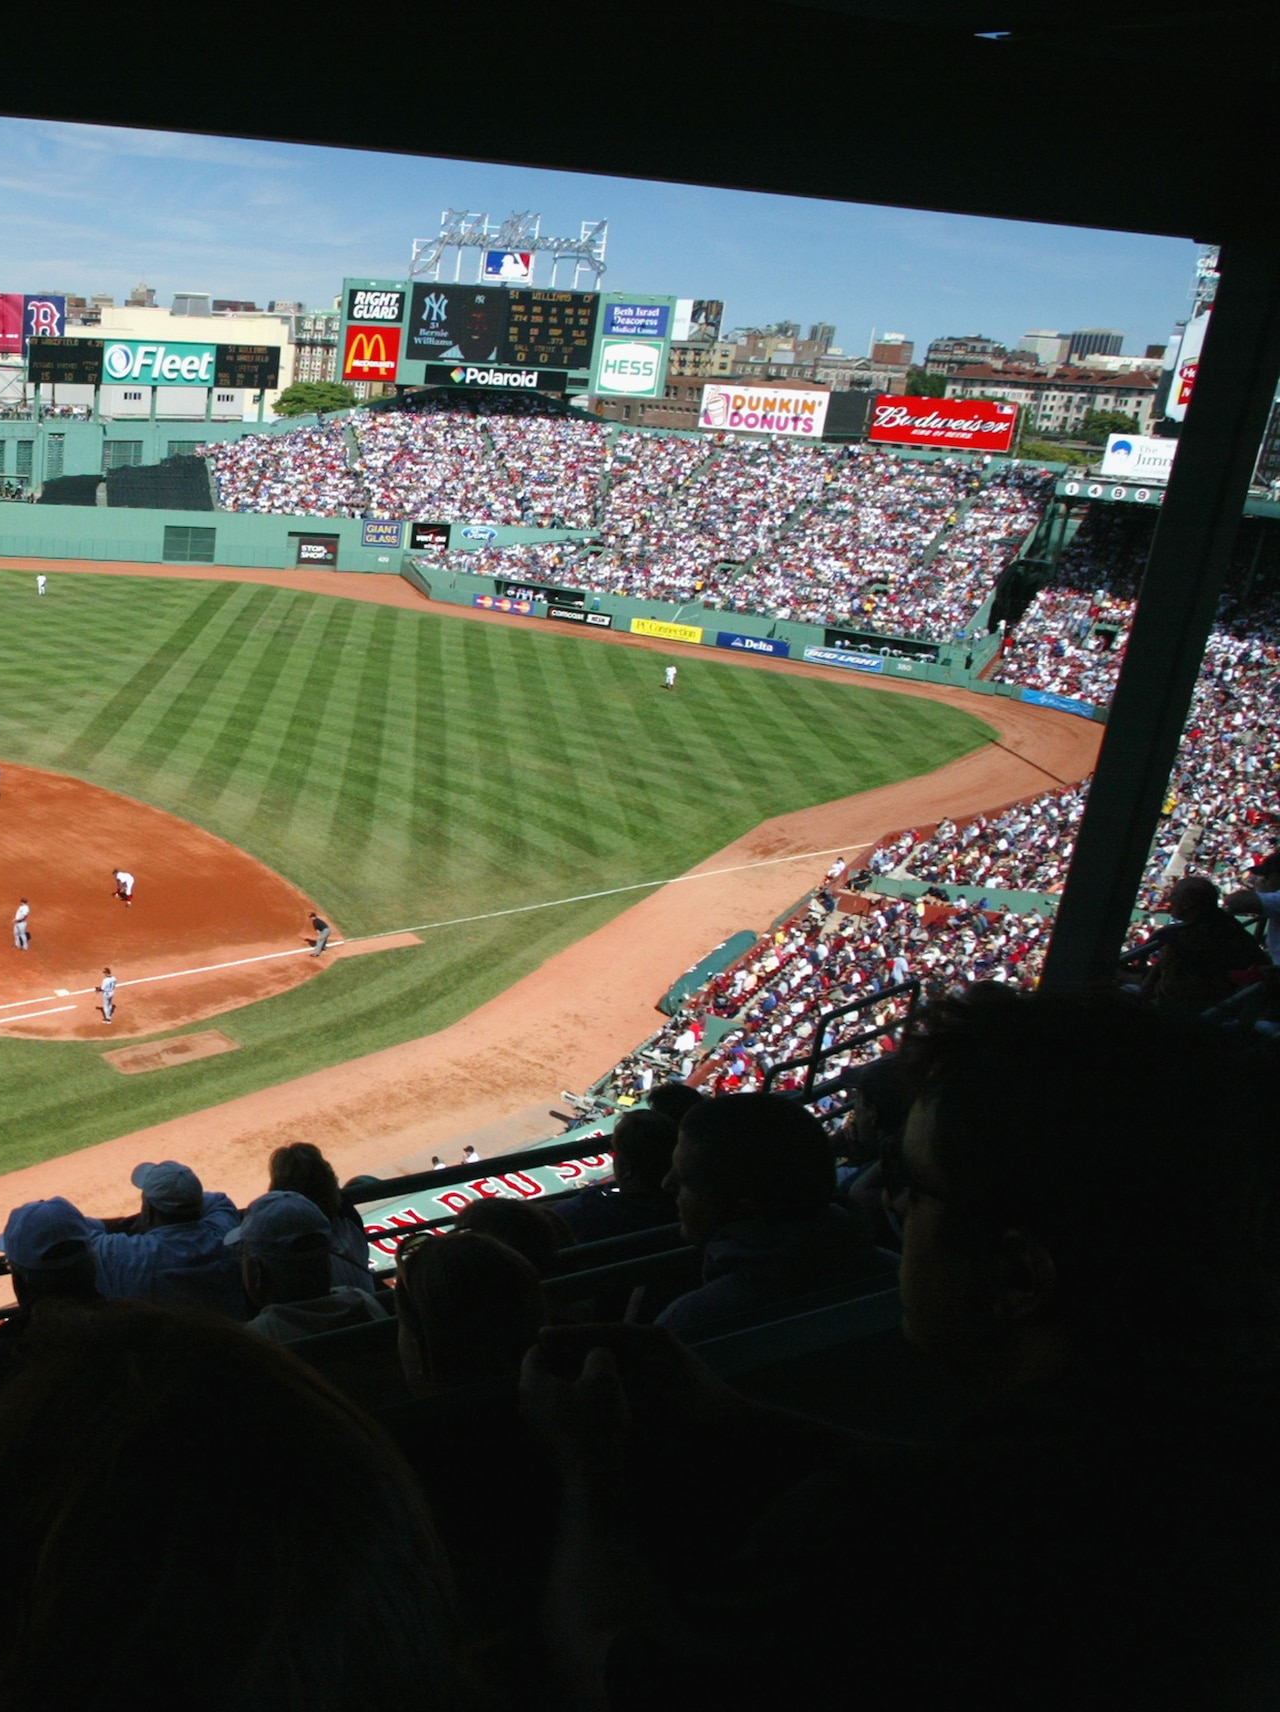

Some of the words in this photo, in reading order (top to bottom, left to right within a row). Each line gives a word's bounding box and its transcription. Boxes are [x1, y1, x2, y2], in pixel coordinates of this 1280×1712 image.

[354, 291, 400, 306] RIGHT
[532, 292, 572, 302] WILLIAMS
[352, 304, 398, 320] GUARD
[613, 307, 634, 316] Beth
[635, 307, 660, 317] Israel
[419, 328, 449, 338] Bernie
[637, 327, 658, 335] Center
[413, 336, 454, 346] Williams
[132, 346, 214, 380] Fleet
[351, 359, 395, 369] McDonald's
[604, 359, 654, 376] HESS
[465, 368, 538, 388] Polaroid
[732, 394, 822, 415] DUNKIN'
[729, 412, 814, 433] DONUTS
[874, 406, 1009, 434] Budweiser
[1140, 445, 1158, 454] The
[1069, 484, 1074, 493] 1
[1091, 486, 1098, 495] 4
[366, 524, 398, 534] GIANT
[467, 527, 491, 540] Ford
[365, 534, 397, 544] GLASS
[416, 533, 447, 543] verizon
[301, 551, 325, 559] SHOP
[551, 609, 584, 620] comcast
[650, 622, 696, 638] Connection
[744, 638, 773, 652] Delta
[806, 648, 838, 662] BUD
[840, 654, 881, 668] LIGHT
[896, 663, 912, 672] 380
